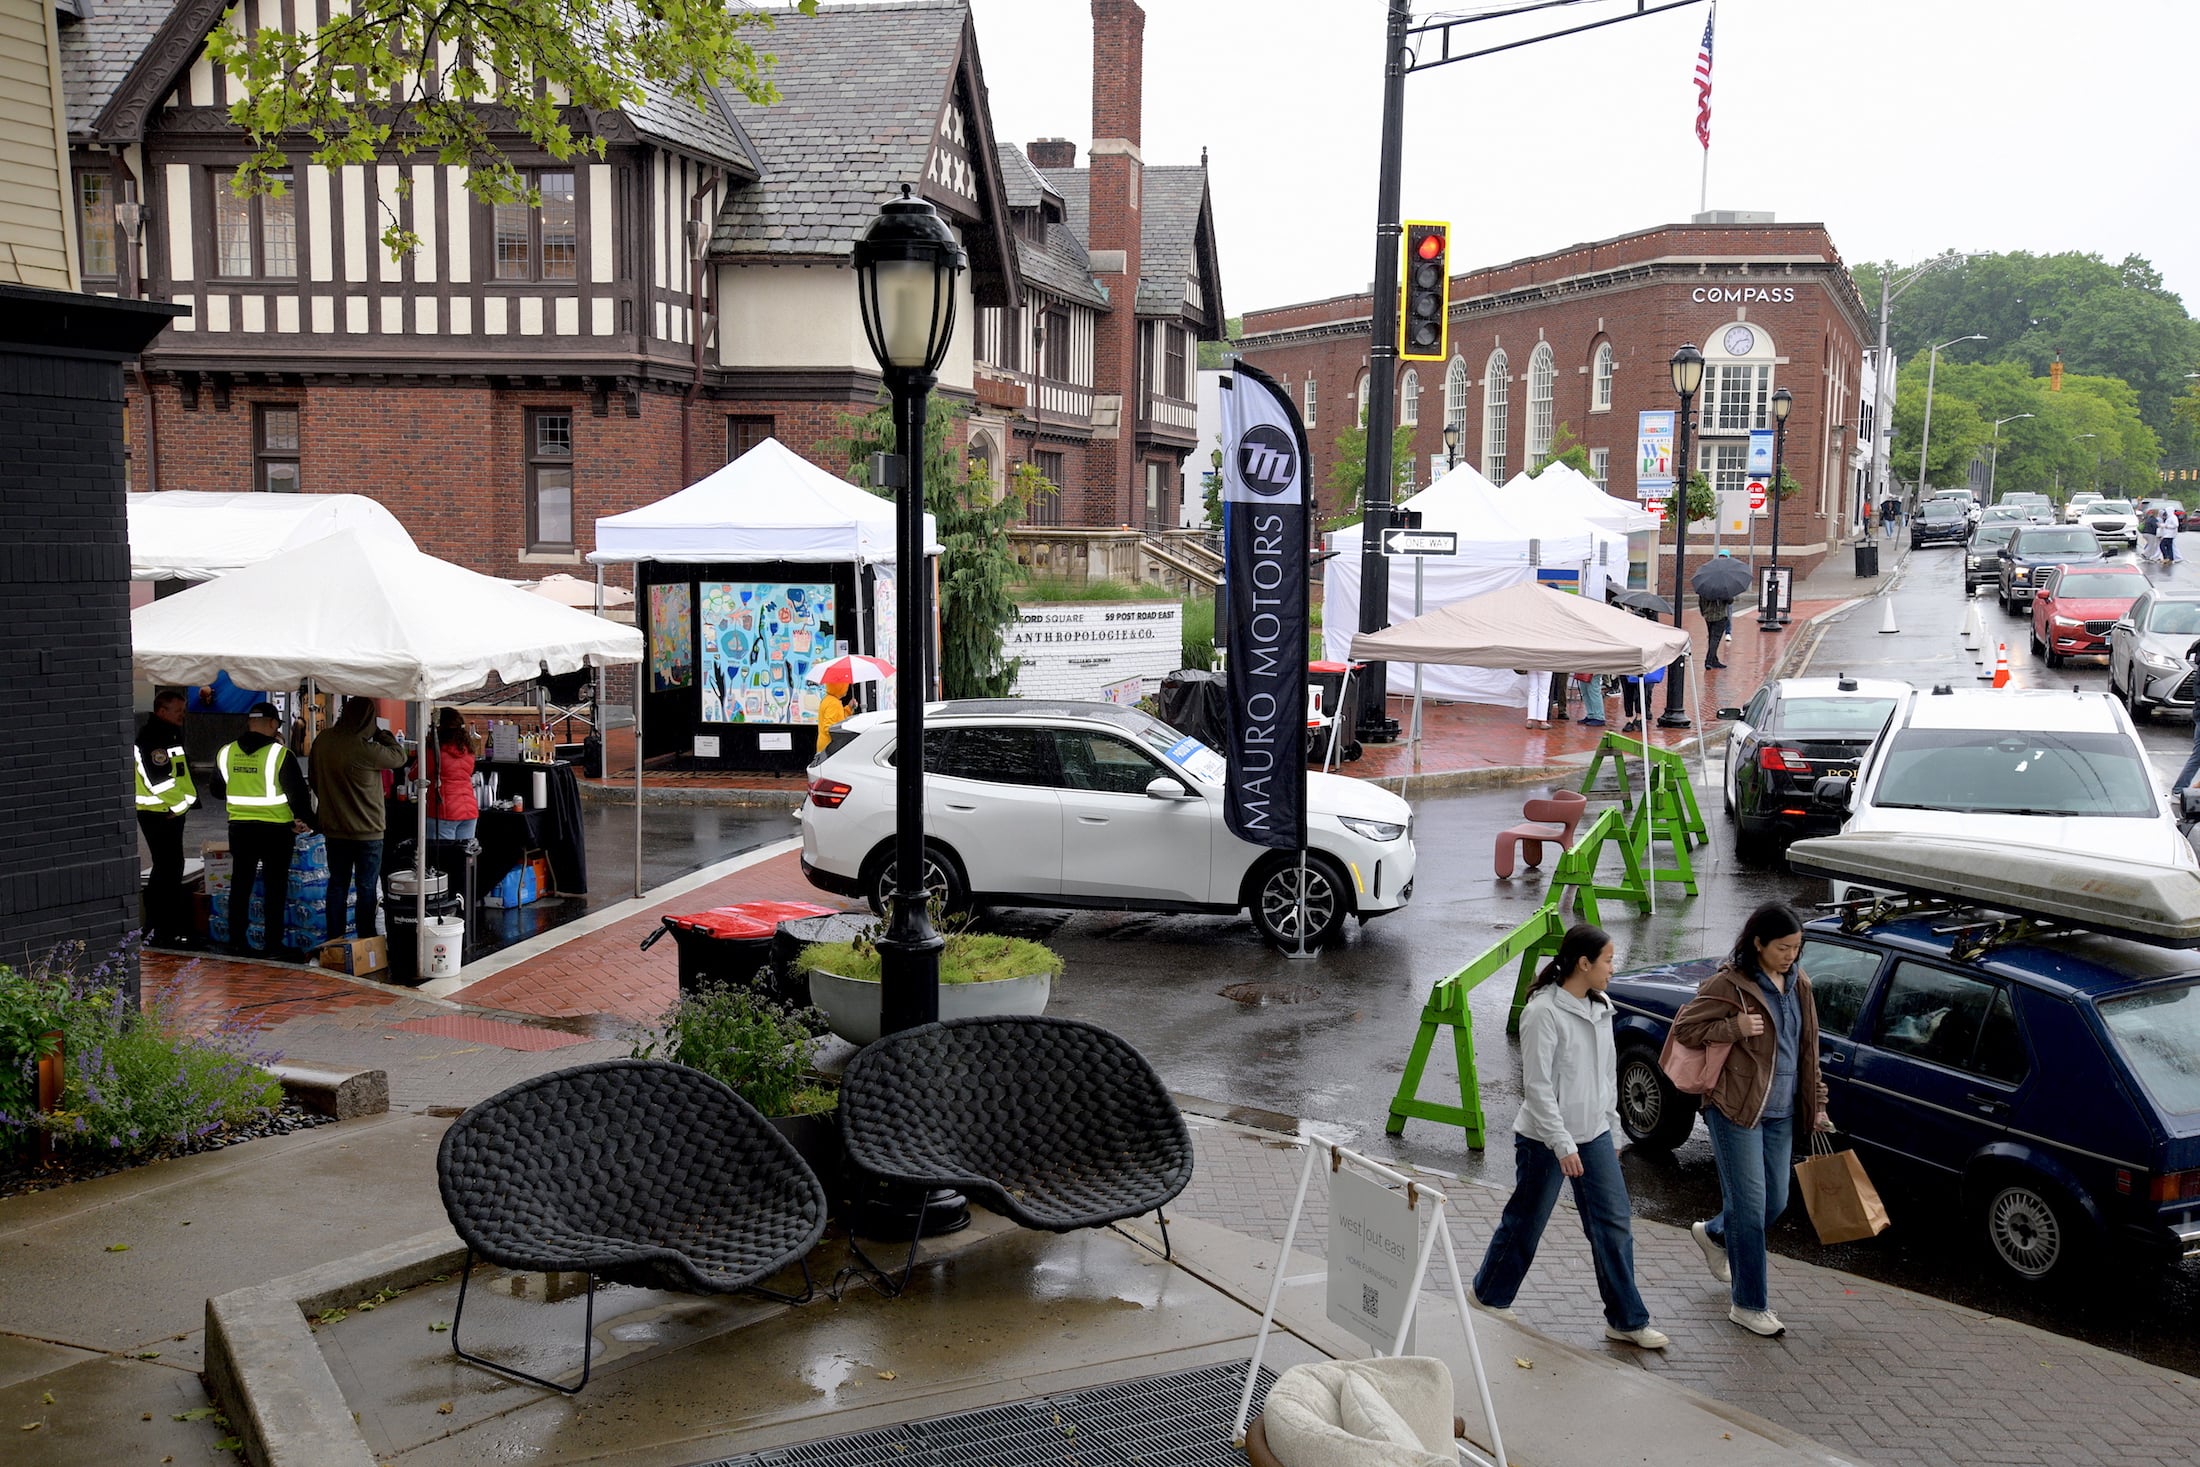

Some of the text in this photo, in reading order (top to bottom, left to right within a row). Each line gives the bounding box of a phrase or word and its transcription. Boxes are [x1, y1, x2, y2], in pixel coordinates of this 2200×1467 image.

[1692, 287, 1795, 303] COMPASS
[1405, 538, 1450, 548] ONE WAY
[1045, 614, 1084, 623] SQUARE
[1105, 612, 1115, 621] 59
[1117, 612, 1135, 621] POST
[1137, 611, 1157, 620] ROAD
[1158, 611, 1175, 619] EAST
[1242, 514, 1284, 830] MAURO MOTORS
[1365, 1228, 1383, 1248] out
[1384, 1238, 1406, 1260] east
[1345, 1255, 1398, 1290] HOME FURNISHINGS
